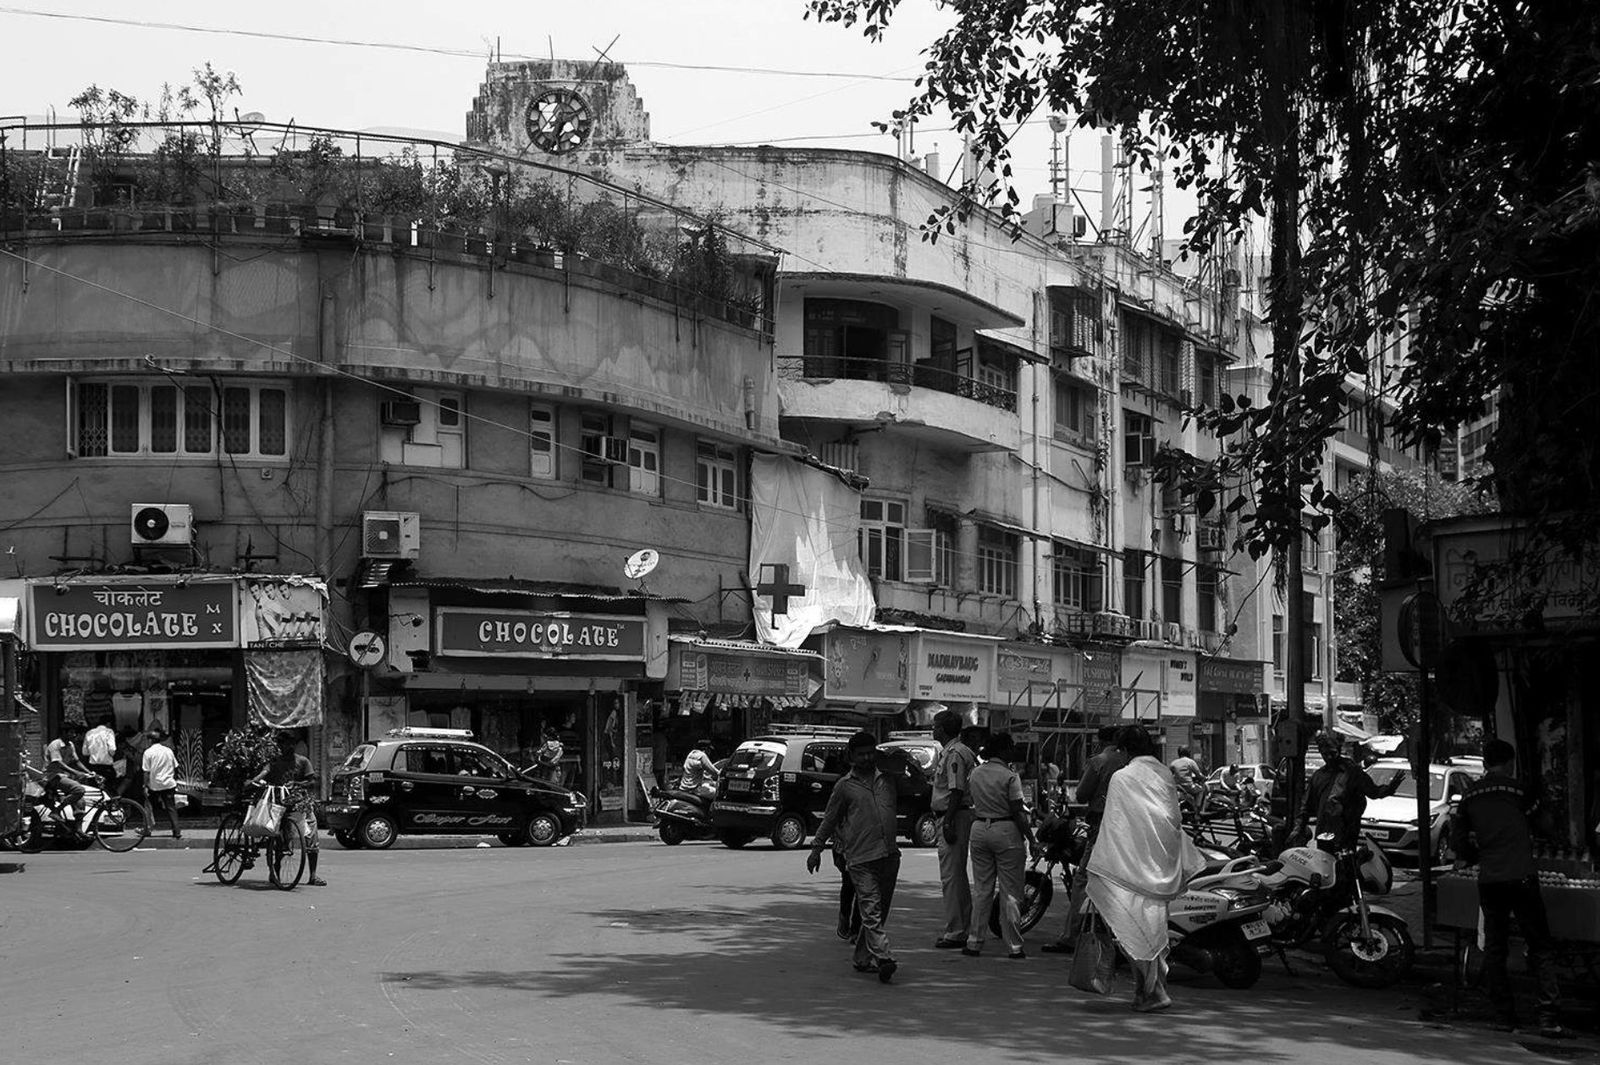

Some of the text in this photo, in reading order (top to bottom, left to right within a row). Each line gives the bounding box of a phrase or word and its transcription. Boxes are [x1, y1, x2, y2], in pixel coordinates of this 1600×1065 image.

[93, 586, 164, 607] चोकलेट
[205, 603, 221, 614] M
[45, 611, 198, 638] CHOCOLATE
[479, 620, 618, 646] CHOCOLATE
[1288, 853, 1308, 866] POLICE
